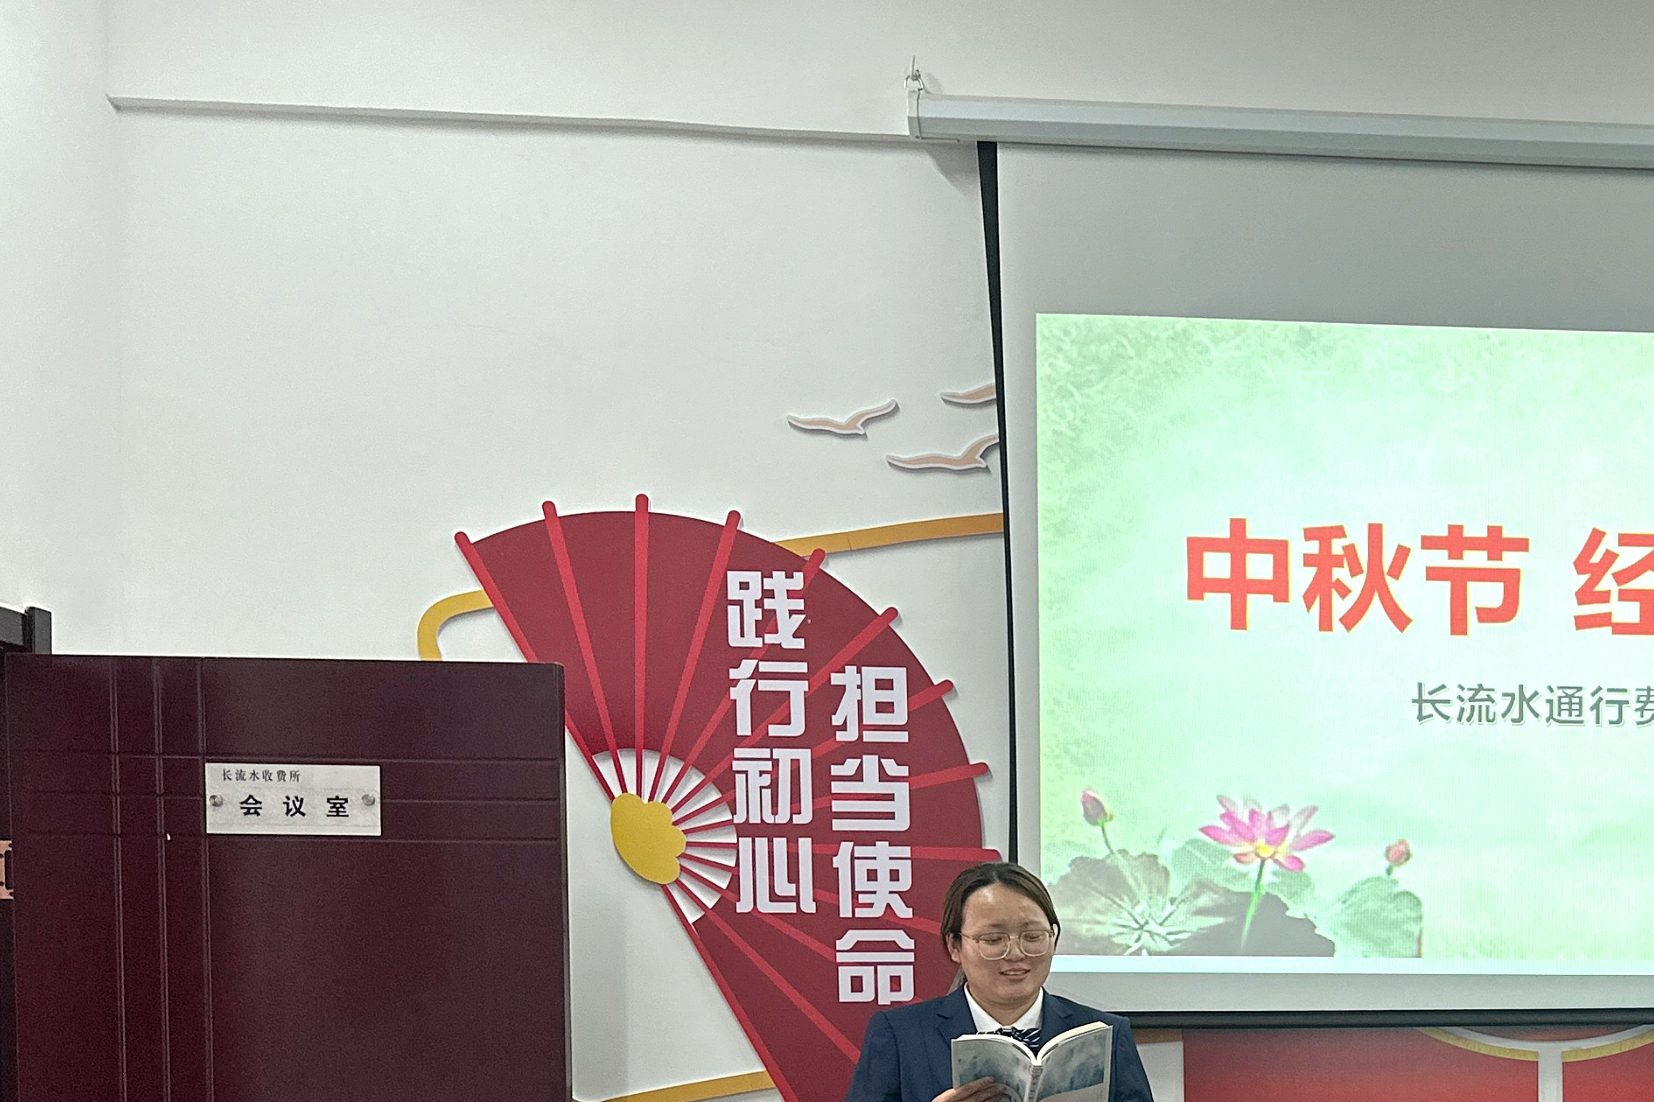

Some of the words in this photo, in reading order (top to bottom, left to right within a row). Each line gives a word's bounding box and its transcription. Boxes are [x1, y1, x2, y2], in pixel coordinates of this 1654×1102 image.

[1187, 518, 1530, 636] 中秋节
[221, 768, 300, 783] 长流水收费所
[727, 571, 816, 913] 践行初心
[239, 794, 349, 818] 会议室
[830, 666, 915, 1005] 担当使命
